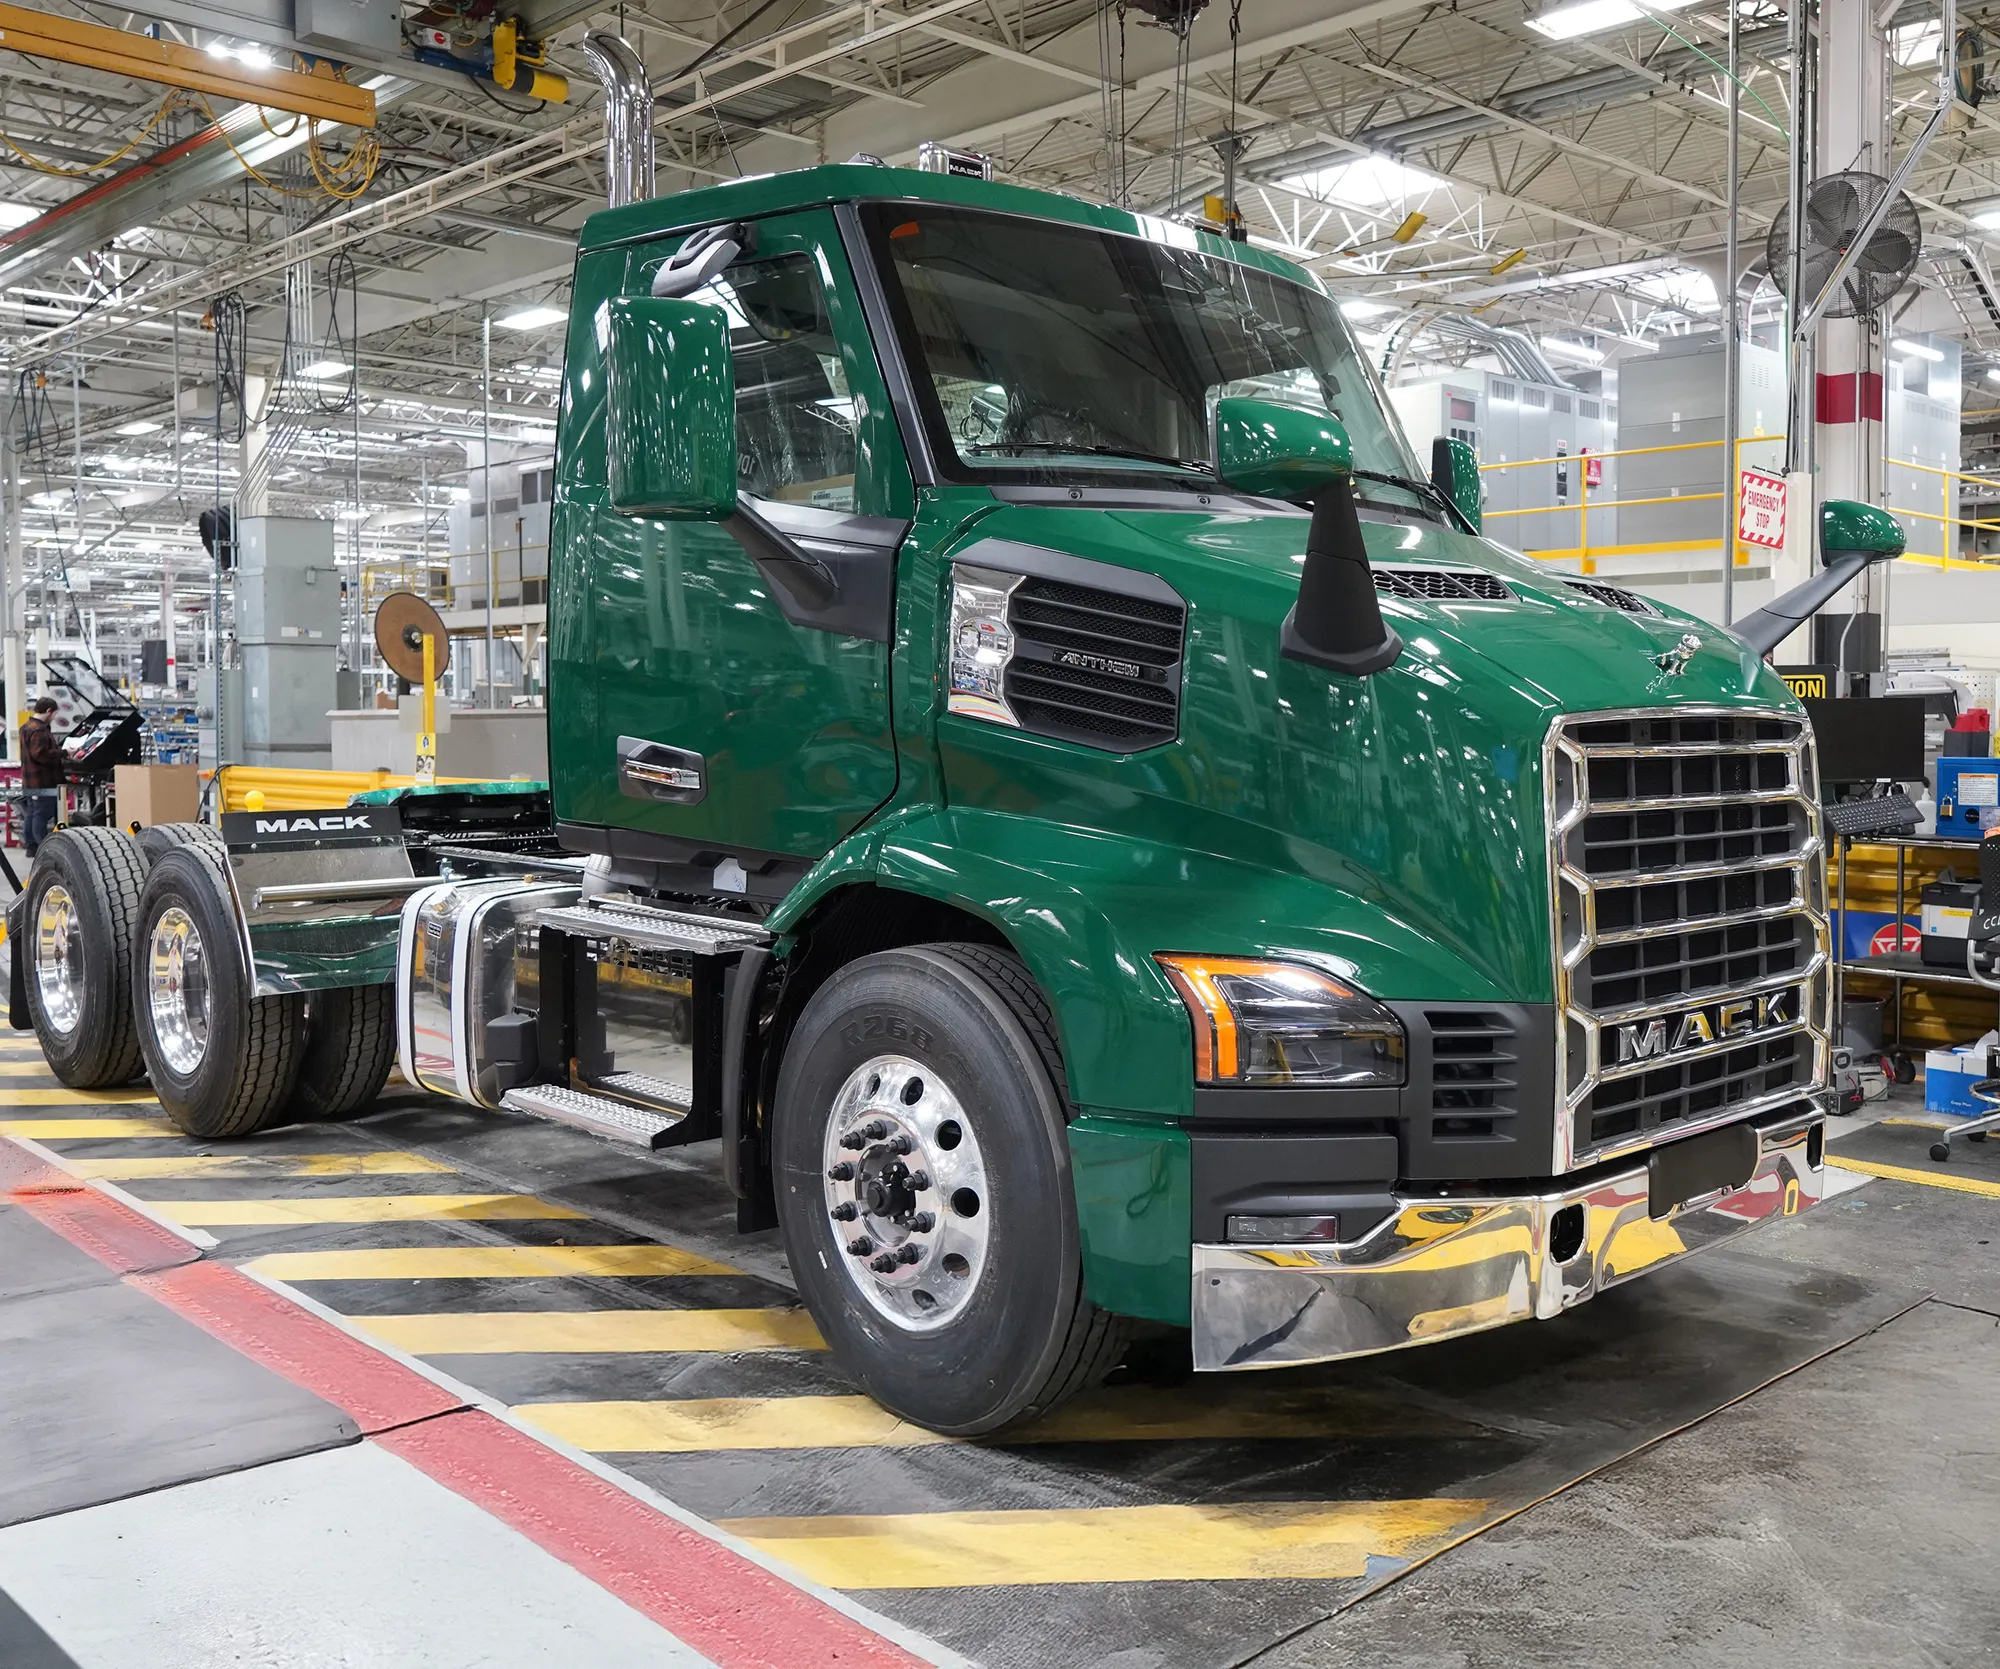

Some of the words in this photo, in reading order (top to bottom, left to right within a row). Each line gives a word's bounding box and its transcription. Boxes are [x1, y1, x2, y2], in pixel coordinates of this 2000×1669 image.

[949, 164, 983, 178] MACK
[1748, 490, 1780, 512] EMERGENCY
[1756, 512, 1770, 529] STOP
[1060, 651, 1140, 678] ANTHEM
[255, 815, 373, 834] MACK
[840, 1014, 934, 1055] R268
[1617, 991, 1788, 1062] MACK
